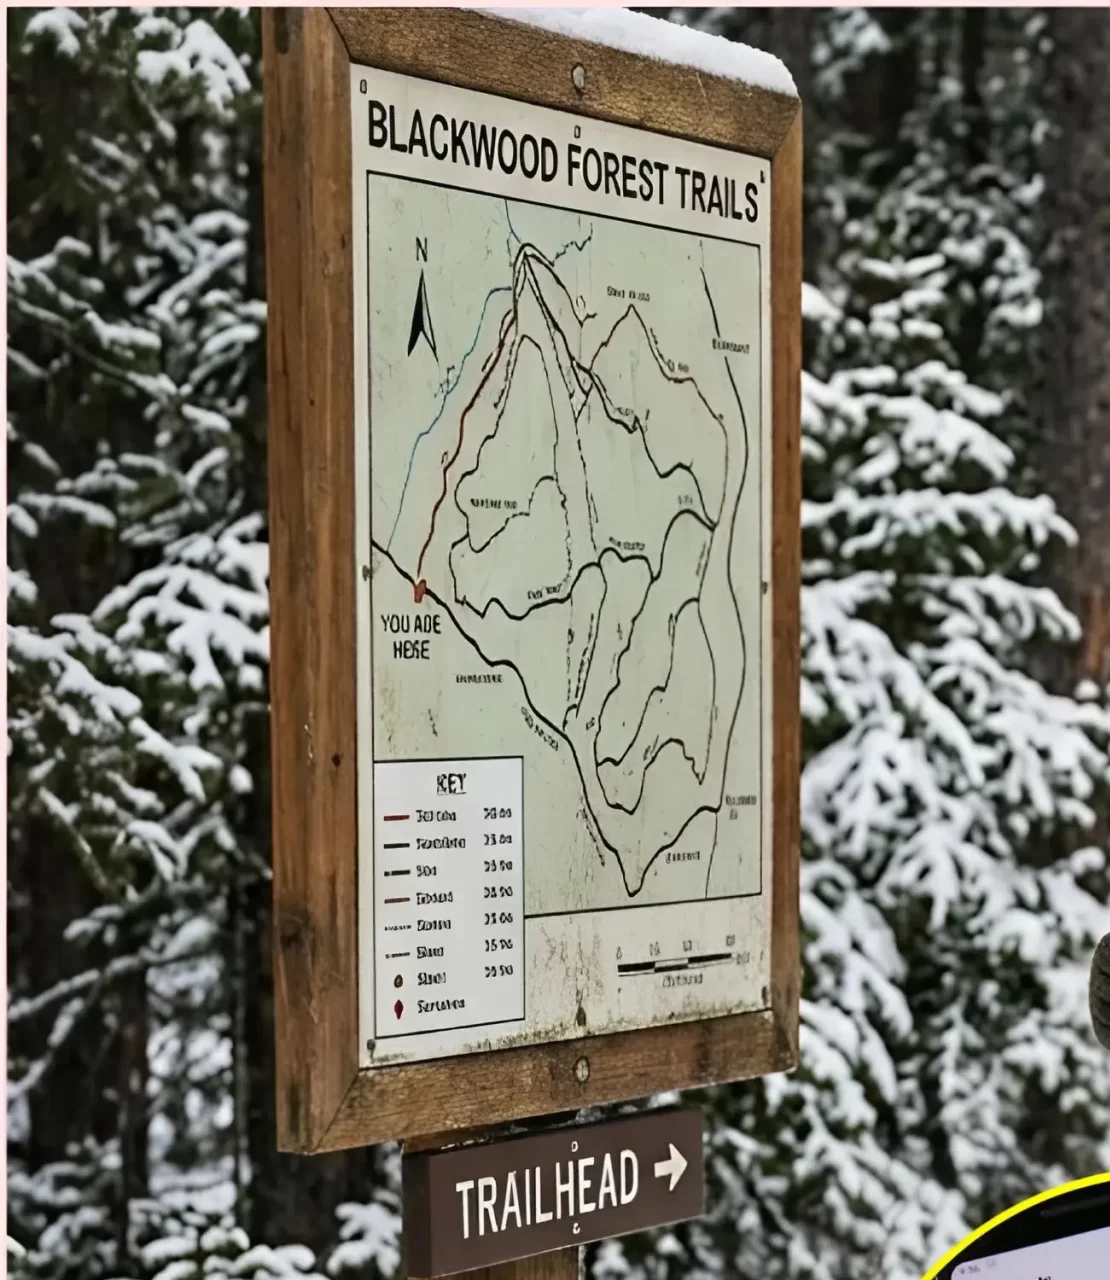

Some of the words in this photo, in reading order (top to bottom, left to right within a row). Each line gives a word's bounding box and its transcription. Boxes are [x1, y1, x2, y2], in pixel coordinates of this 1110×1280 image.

[369, 100, 558, 182] BLACKWOOD
[568, 144, 669, 204] FOREST
[675, 167, 758, 222] TRAILS
[416, 237, 427, 262] N
[381, 615, 409, 633] YOU
[456, 1150, 638, 1238] TRAILHEAD
